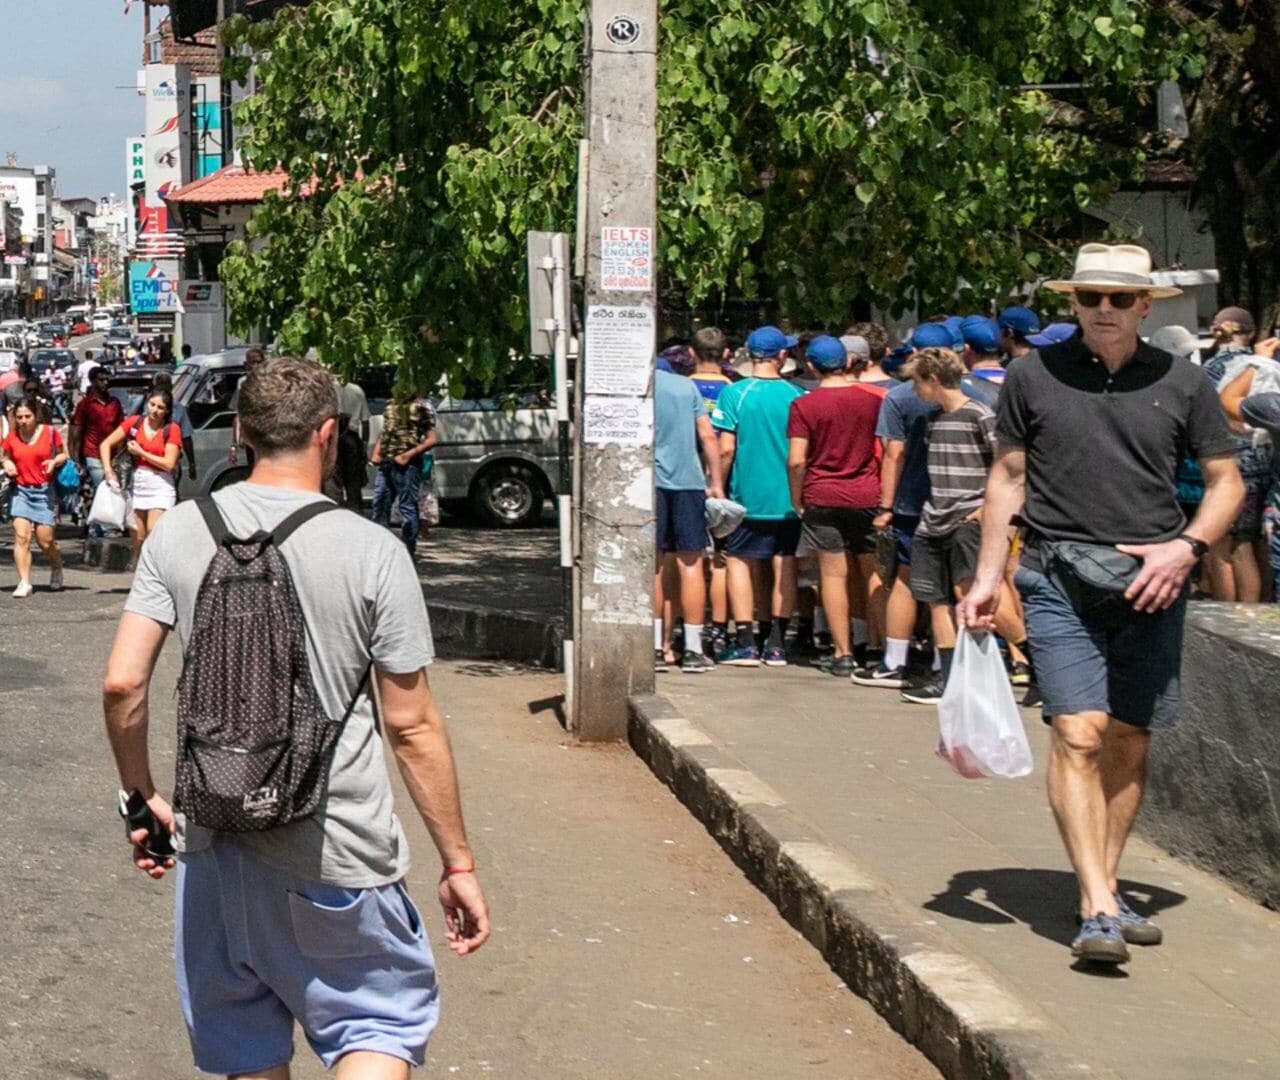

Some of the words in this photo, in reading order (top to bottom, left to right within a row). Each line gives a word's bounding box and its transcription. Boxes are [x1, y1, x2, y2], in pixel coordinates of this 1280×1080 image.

[603, 228, 649, 241] IELTS
[603, 241, 649, 249] SPOKEN
[603, 248, 649, 257] ENGLISH
